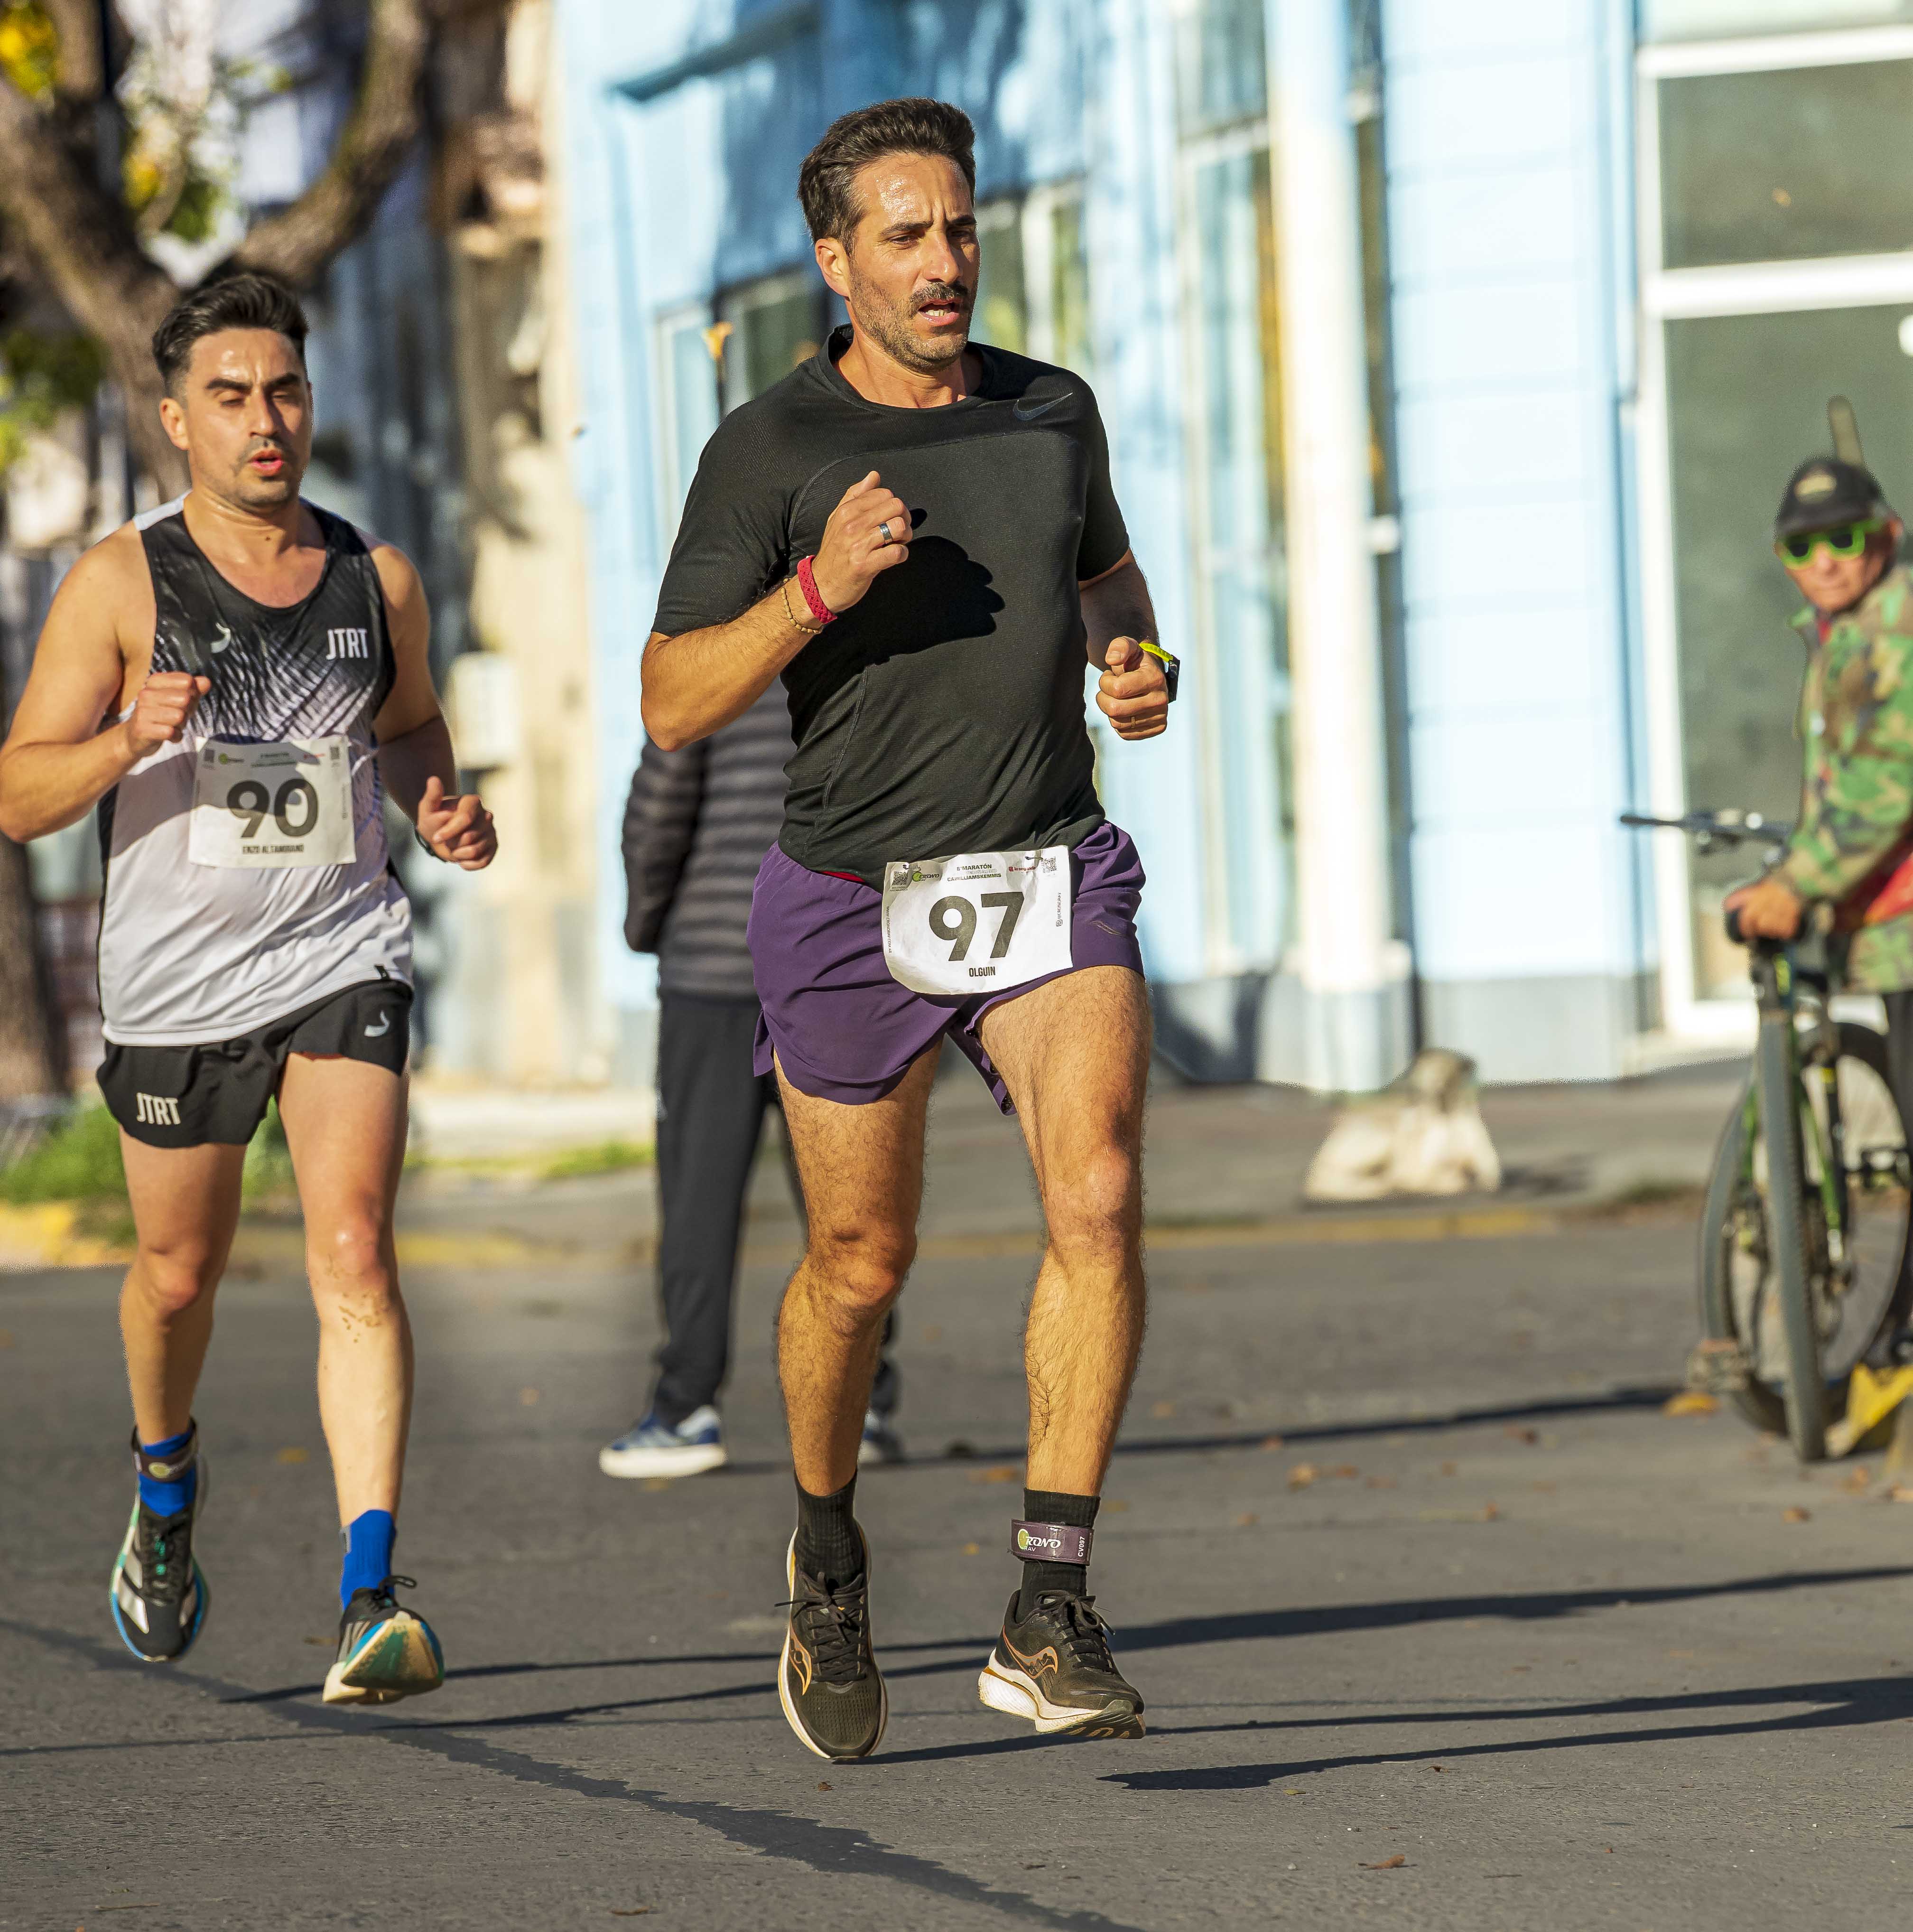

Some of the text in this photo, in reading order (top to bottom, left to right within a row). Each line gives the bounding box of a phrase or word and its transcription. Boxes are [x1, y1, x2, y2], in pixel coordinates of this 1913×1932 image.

[325, 628, 368, 660] JTRT
[227, 778, 319, 838] 90
[929, 891, 1025, 961] 97
[136, 1092, 181, 1125] JTRT
[1077, 1536, 1086, 1557] CV097
